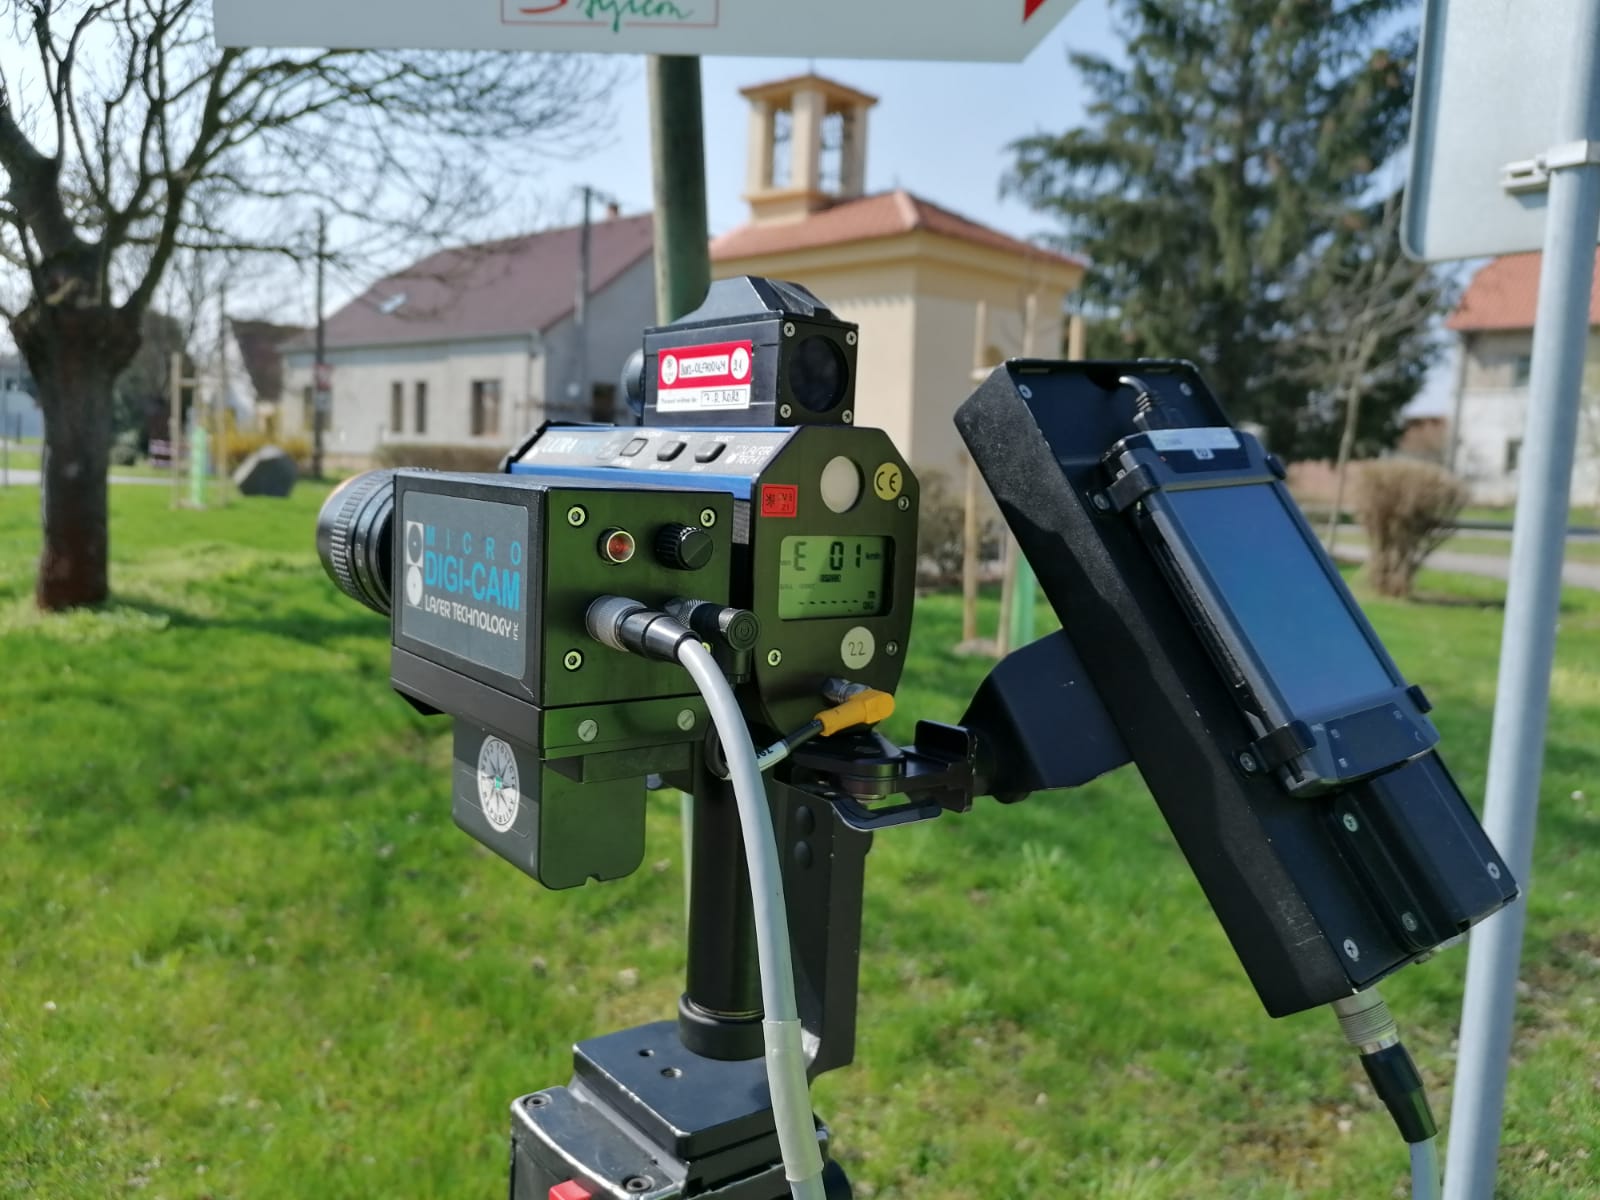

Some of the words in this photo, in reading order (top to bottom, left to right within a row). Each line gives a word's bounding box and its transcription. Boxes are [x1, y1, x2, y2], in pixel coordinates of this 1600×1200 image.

[876, 471, 899, 493] CE
[424, 524, 522, 566] MICRO
[793, 541, 807, 571] E
[829, 541, 862, 571] 01
[424, 550, 521, 612] DIGI-CAM
[424, 594, 451, 619] LASER
[451, 602, 513, 638] TECHNOLOGY
[848, 641, 866, 656] 22
